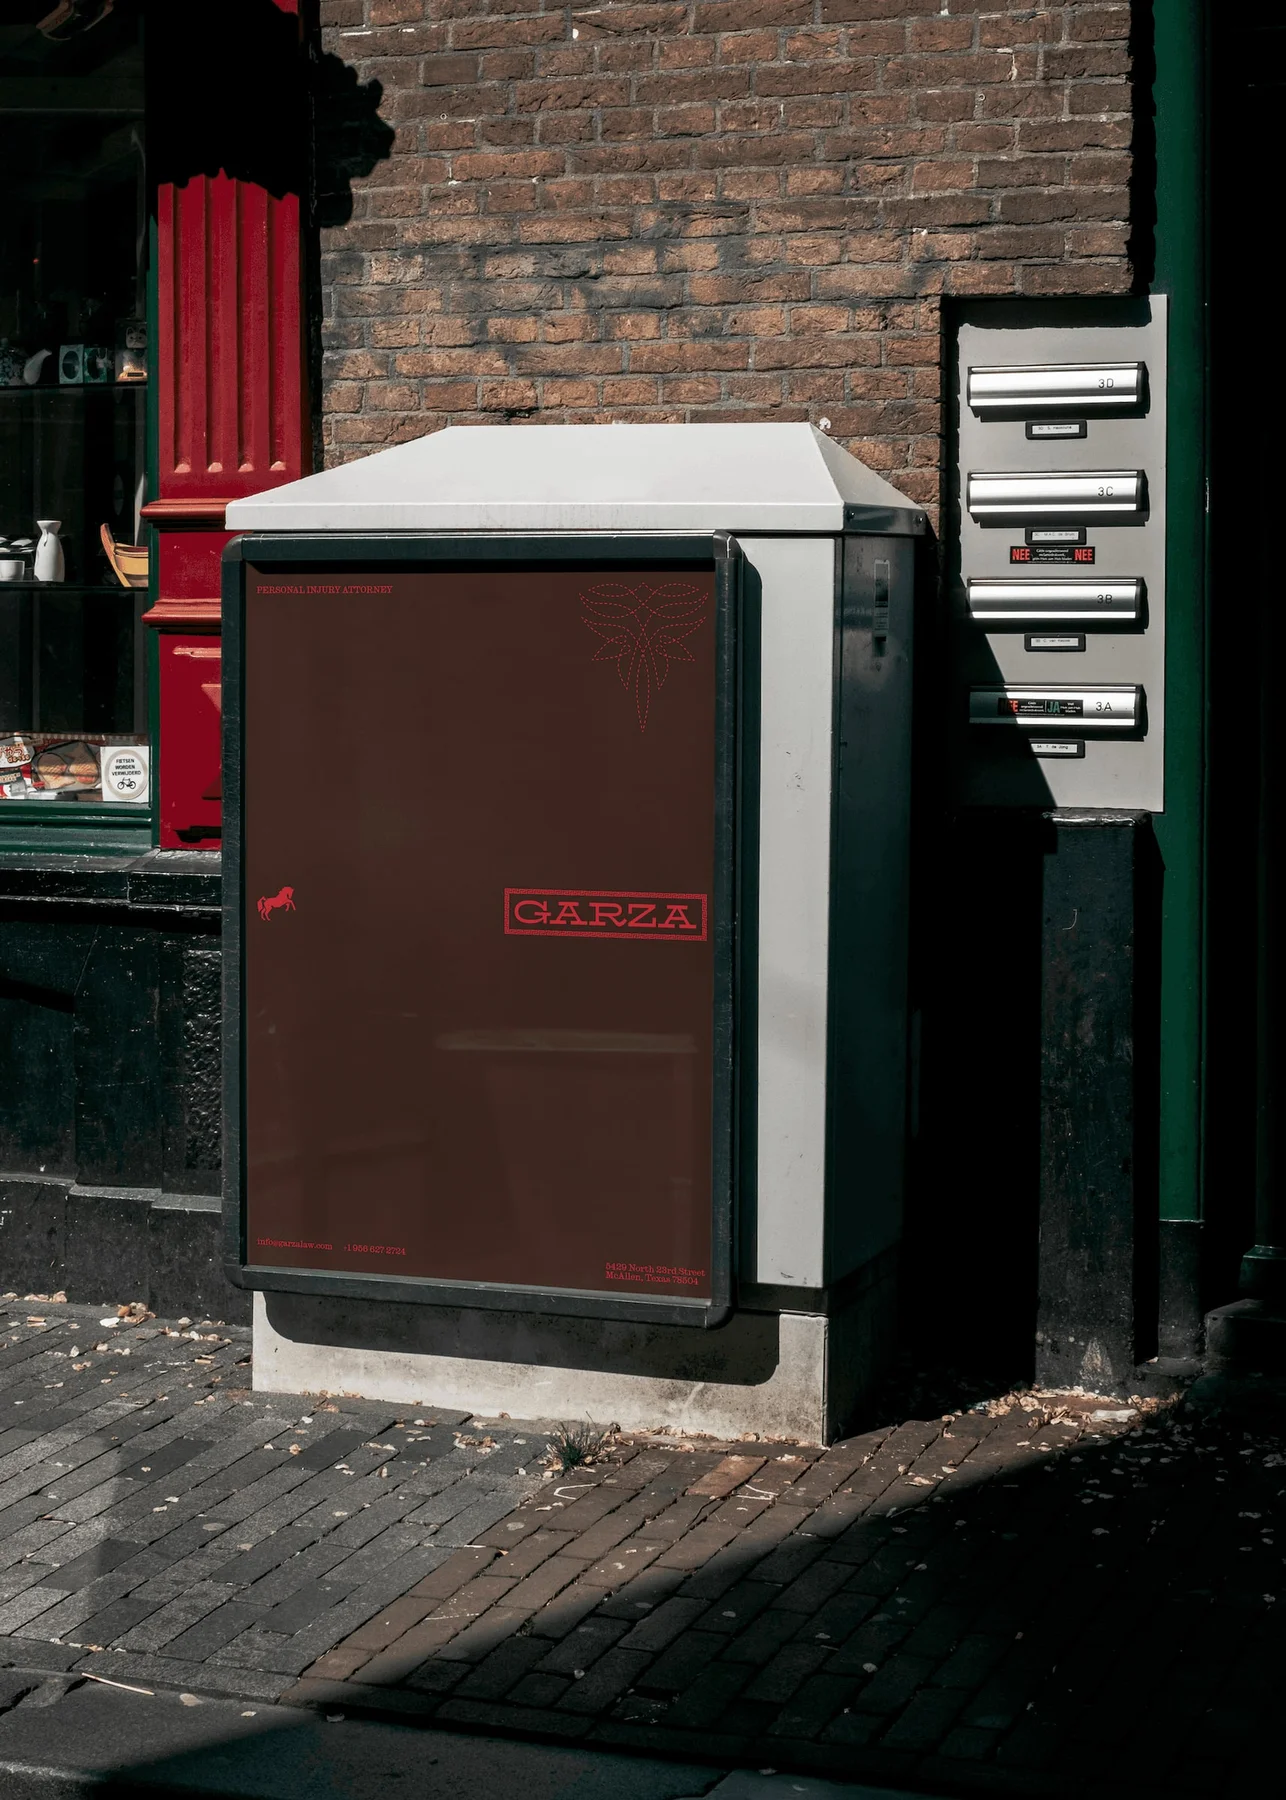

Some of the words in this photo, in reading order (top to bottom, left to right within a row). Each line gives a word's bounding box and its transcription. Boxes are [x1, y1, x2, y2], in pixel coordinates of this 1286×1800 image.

[1098, 378, 1114, 389] 3D
[1097, 486, 1113, 497] 3C
[1012, 549, 1030, 560] NEE
[1075, 549, 1093, 561] NEE
[256, 585, 306, 594] PERSONAL
[306, 585, 341, 594] INJURY
[342, 585, 393, 594] ATTORNEY
[1097, 594, 1113, 605] 3B
[1047, 701, 1060, 713] JA
[1095, 702, 1113, 712] 3A
[514, 900, 697, 929] GARZA
[257, 1237, 333, 1251] info@garzalaw.com
[352, 1244, 369, 1253] 956
[369, 1245, 385, 1254] 627
[385, 1246, 406, 1256] 2724
[628, 1263, 655, 1273] North
[656, 1265, 677, 1275] 23rd
[678, 1267, 706, 1277] Street
[605, 1271, 644, 1282] McAllen,
[645, 1273, 671, 1283] Texas
[672, 1275, 699, 1285] 78504
